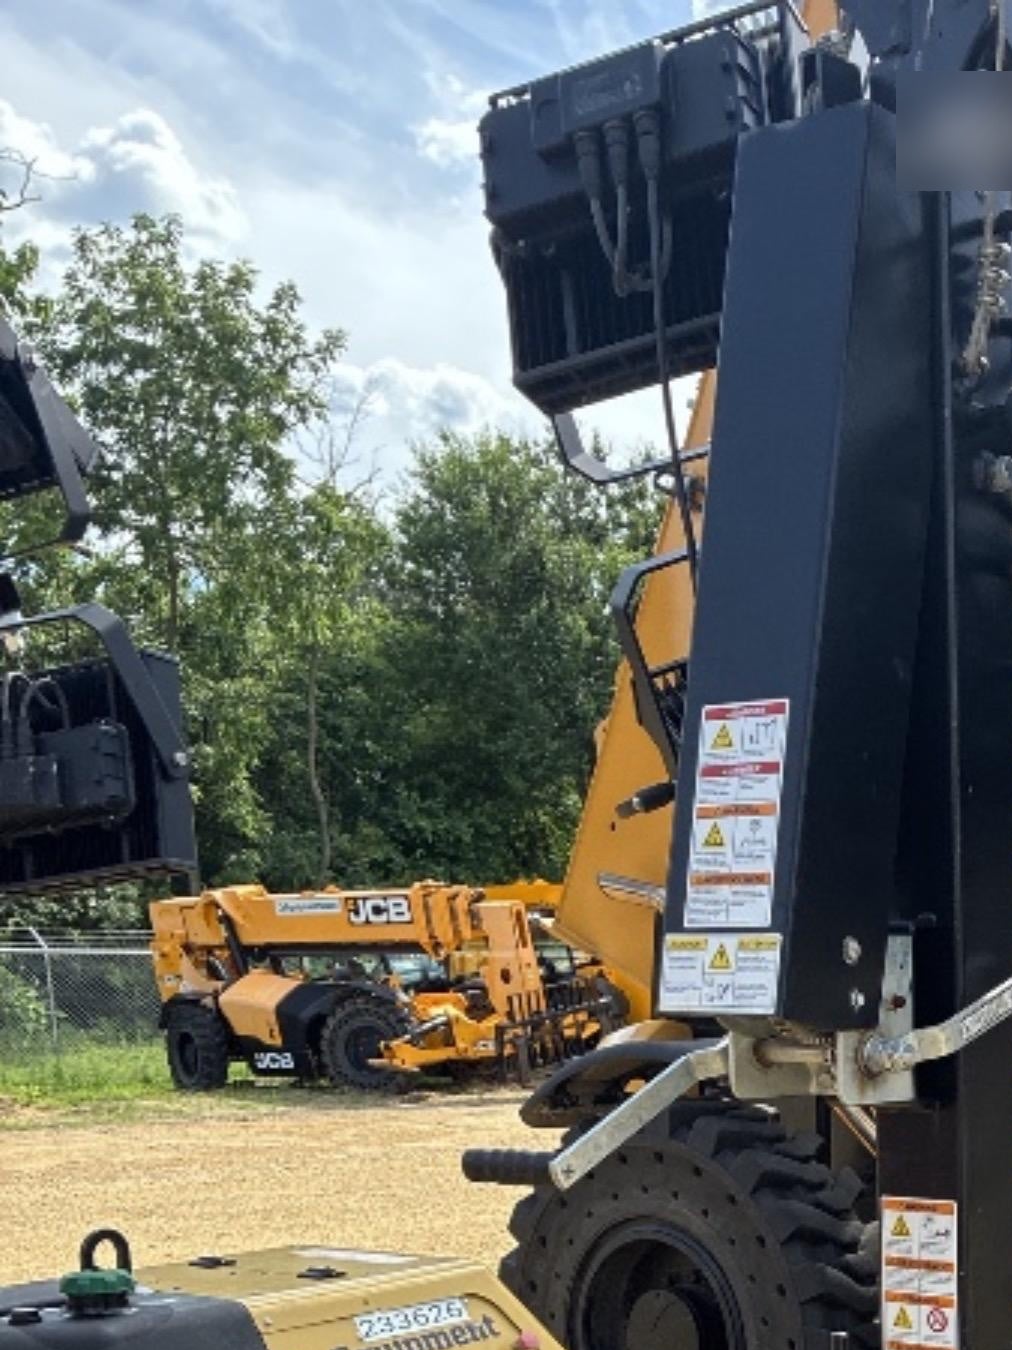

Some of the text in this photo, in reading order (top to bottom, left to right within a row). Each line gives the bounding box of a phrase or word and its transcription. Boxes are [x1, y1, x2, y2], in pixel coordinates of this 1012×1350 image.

[347, 897, 413, 925] JCB
[254, 1051, 295, 1069] JCB
[358, 1302, 464, 1339] 233626
